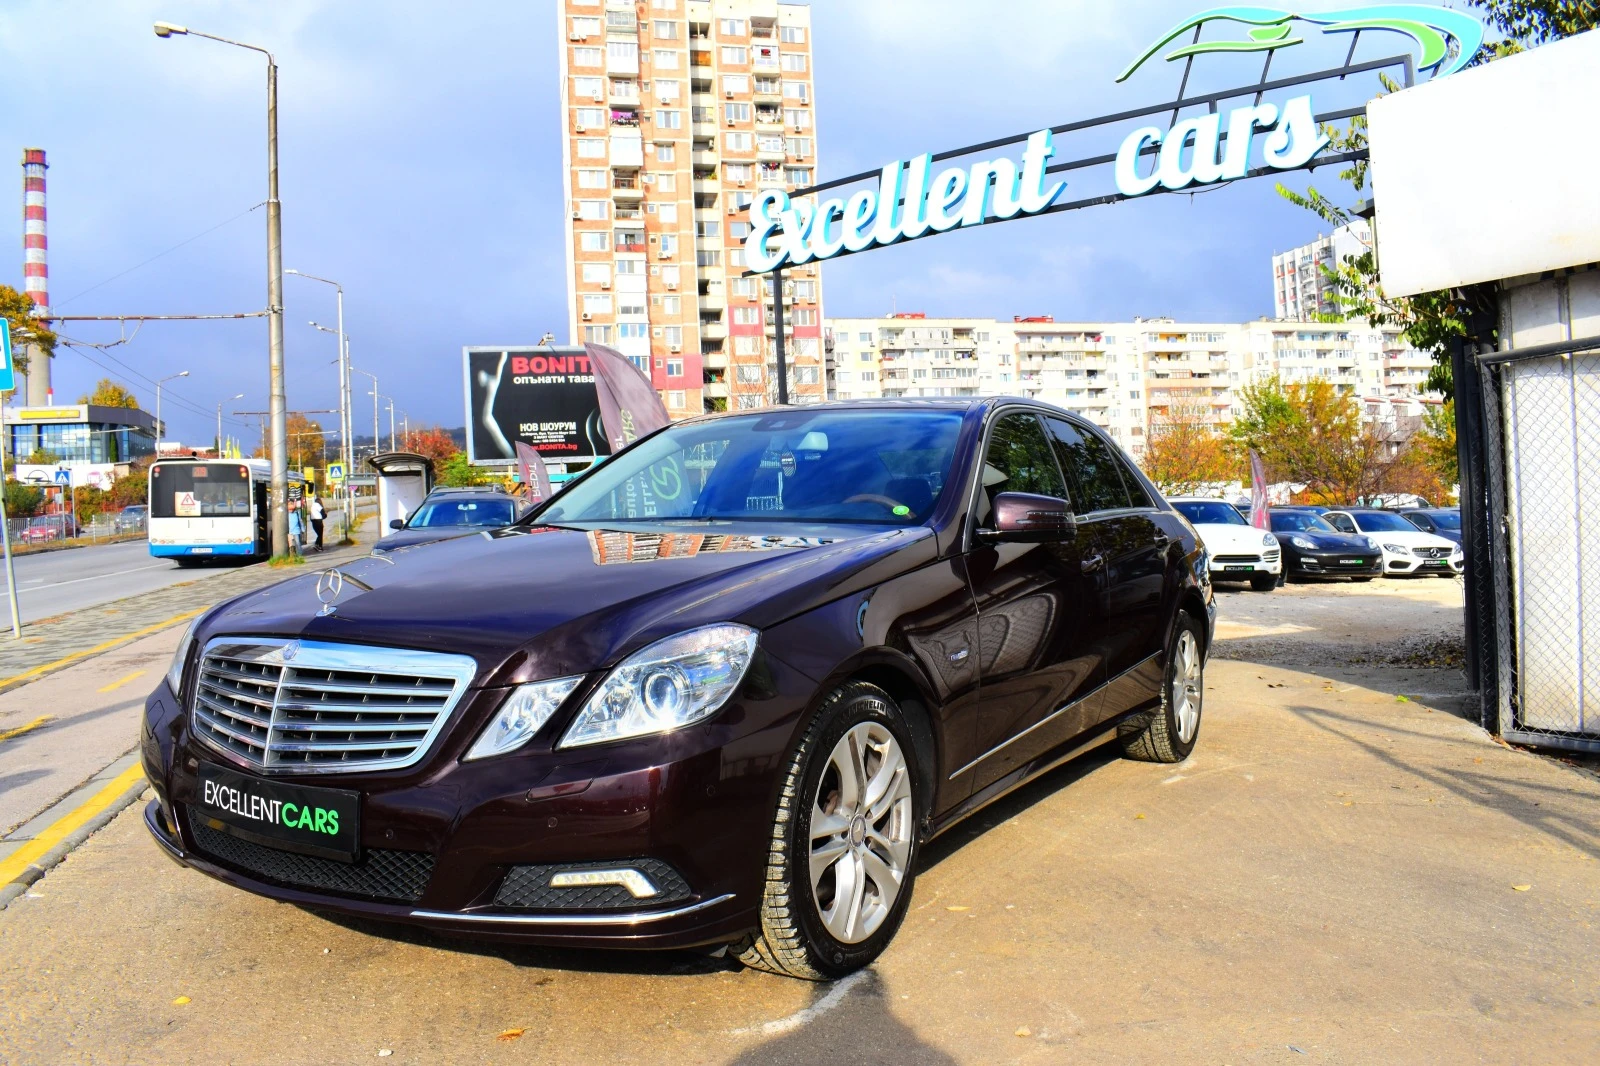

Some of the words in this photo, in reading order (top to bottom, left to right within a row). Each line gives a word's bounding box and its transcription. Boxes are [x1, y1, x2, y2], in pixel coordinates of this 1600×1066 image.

[744, 128, 1068, 273] Excellent
[1115, 94, 1331, 197] cars
[511, 356, 594, 374] BONIT
[513, 375, 565, 385] опънати
[520, 423, 539, 432] НОВ
[540, 421, 577, 432] ШОУРУМ
